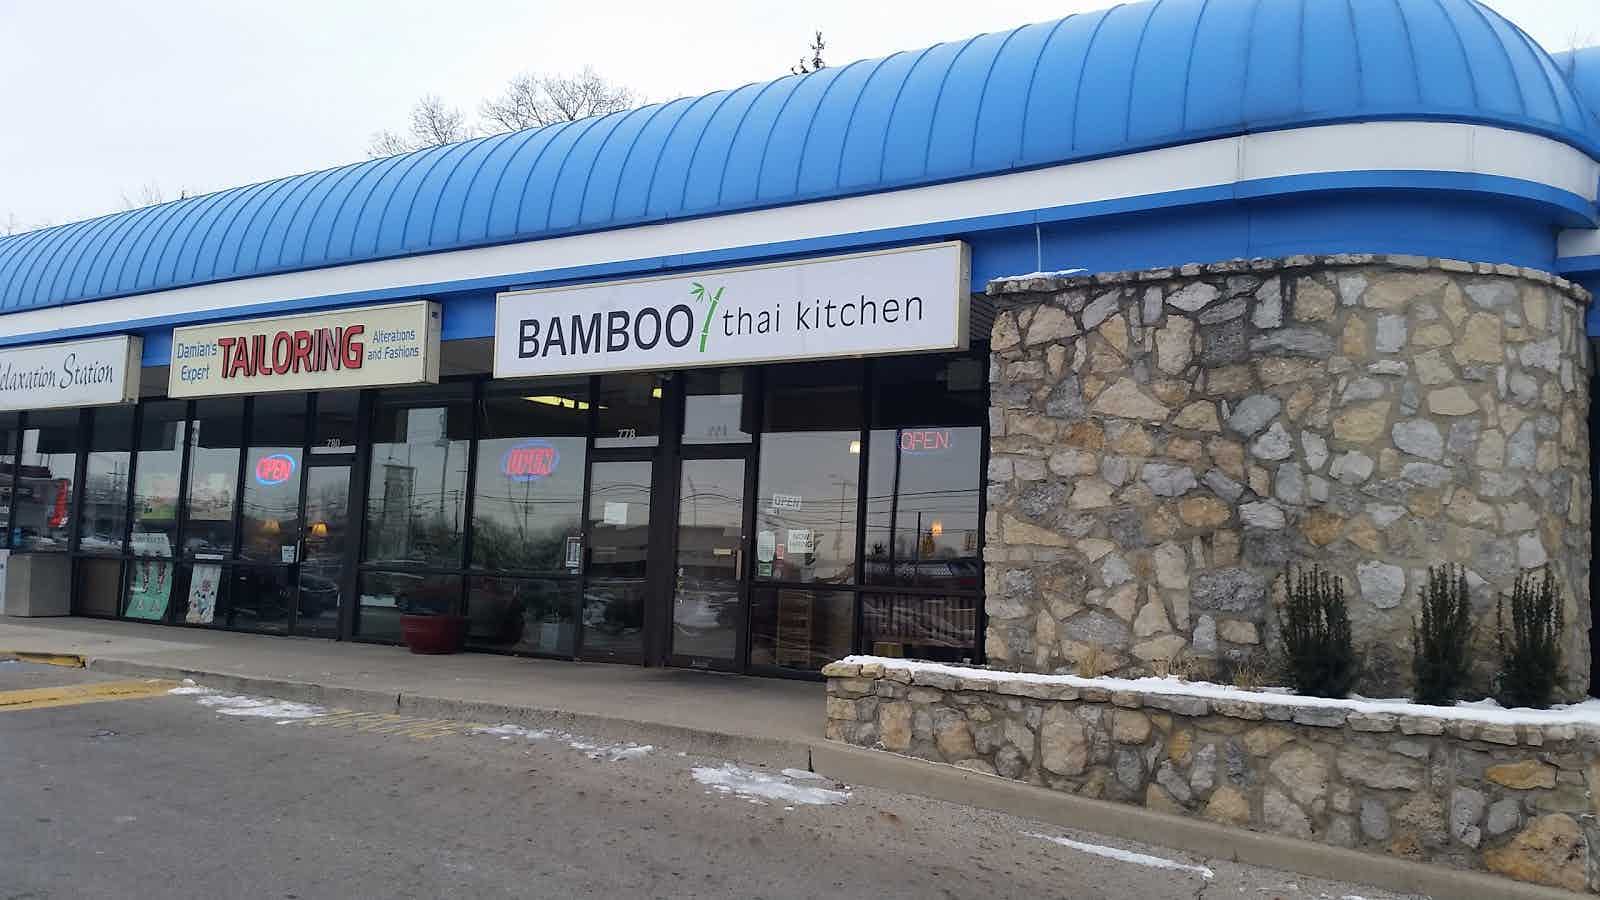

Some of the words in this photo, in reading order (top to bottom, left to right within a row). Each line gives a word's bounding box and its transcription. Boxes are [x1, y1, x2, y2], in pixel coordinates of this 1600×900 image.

[372, 328, 416, 344] Alterations
[518, 304, 694, 359] BAMBOO
[722, 303, 780, 337] thai
[796, 295, 923, 331] kitchen
[176, 341, 217, 360] Damian's
[217, 324, 365, 379] TAILORING
[367, 347, 383, 361] and
[384, 344, 420, 360] Fashions
[0, 362, 56, 392] elaxation
[59, 352, 113, 389] Station
[180, 365, 210, 385] Expert
[617, 428, 636, 440] 778
[900, 431, 949, 450] OPEN
[256, 456, 291, 481] OPEN
[774, 496, 800, 508] OPEN
